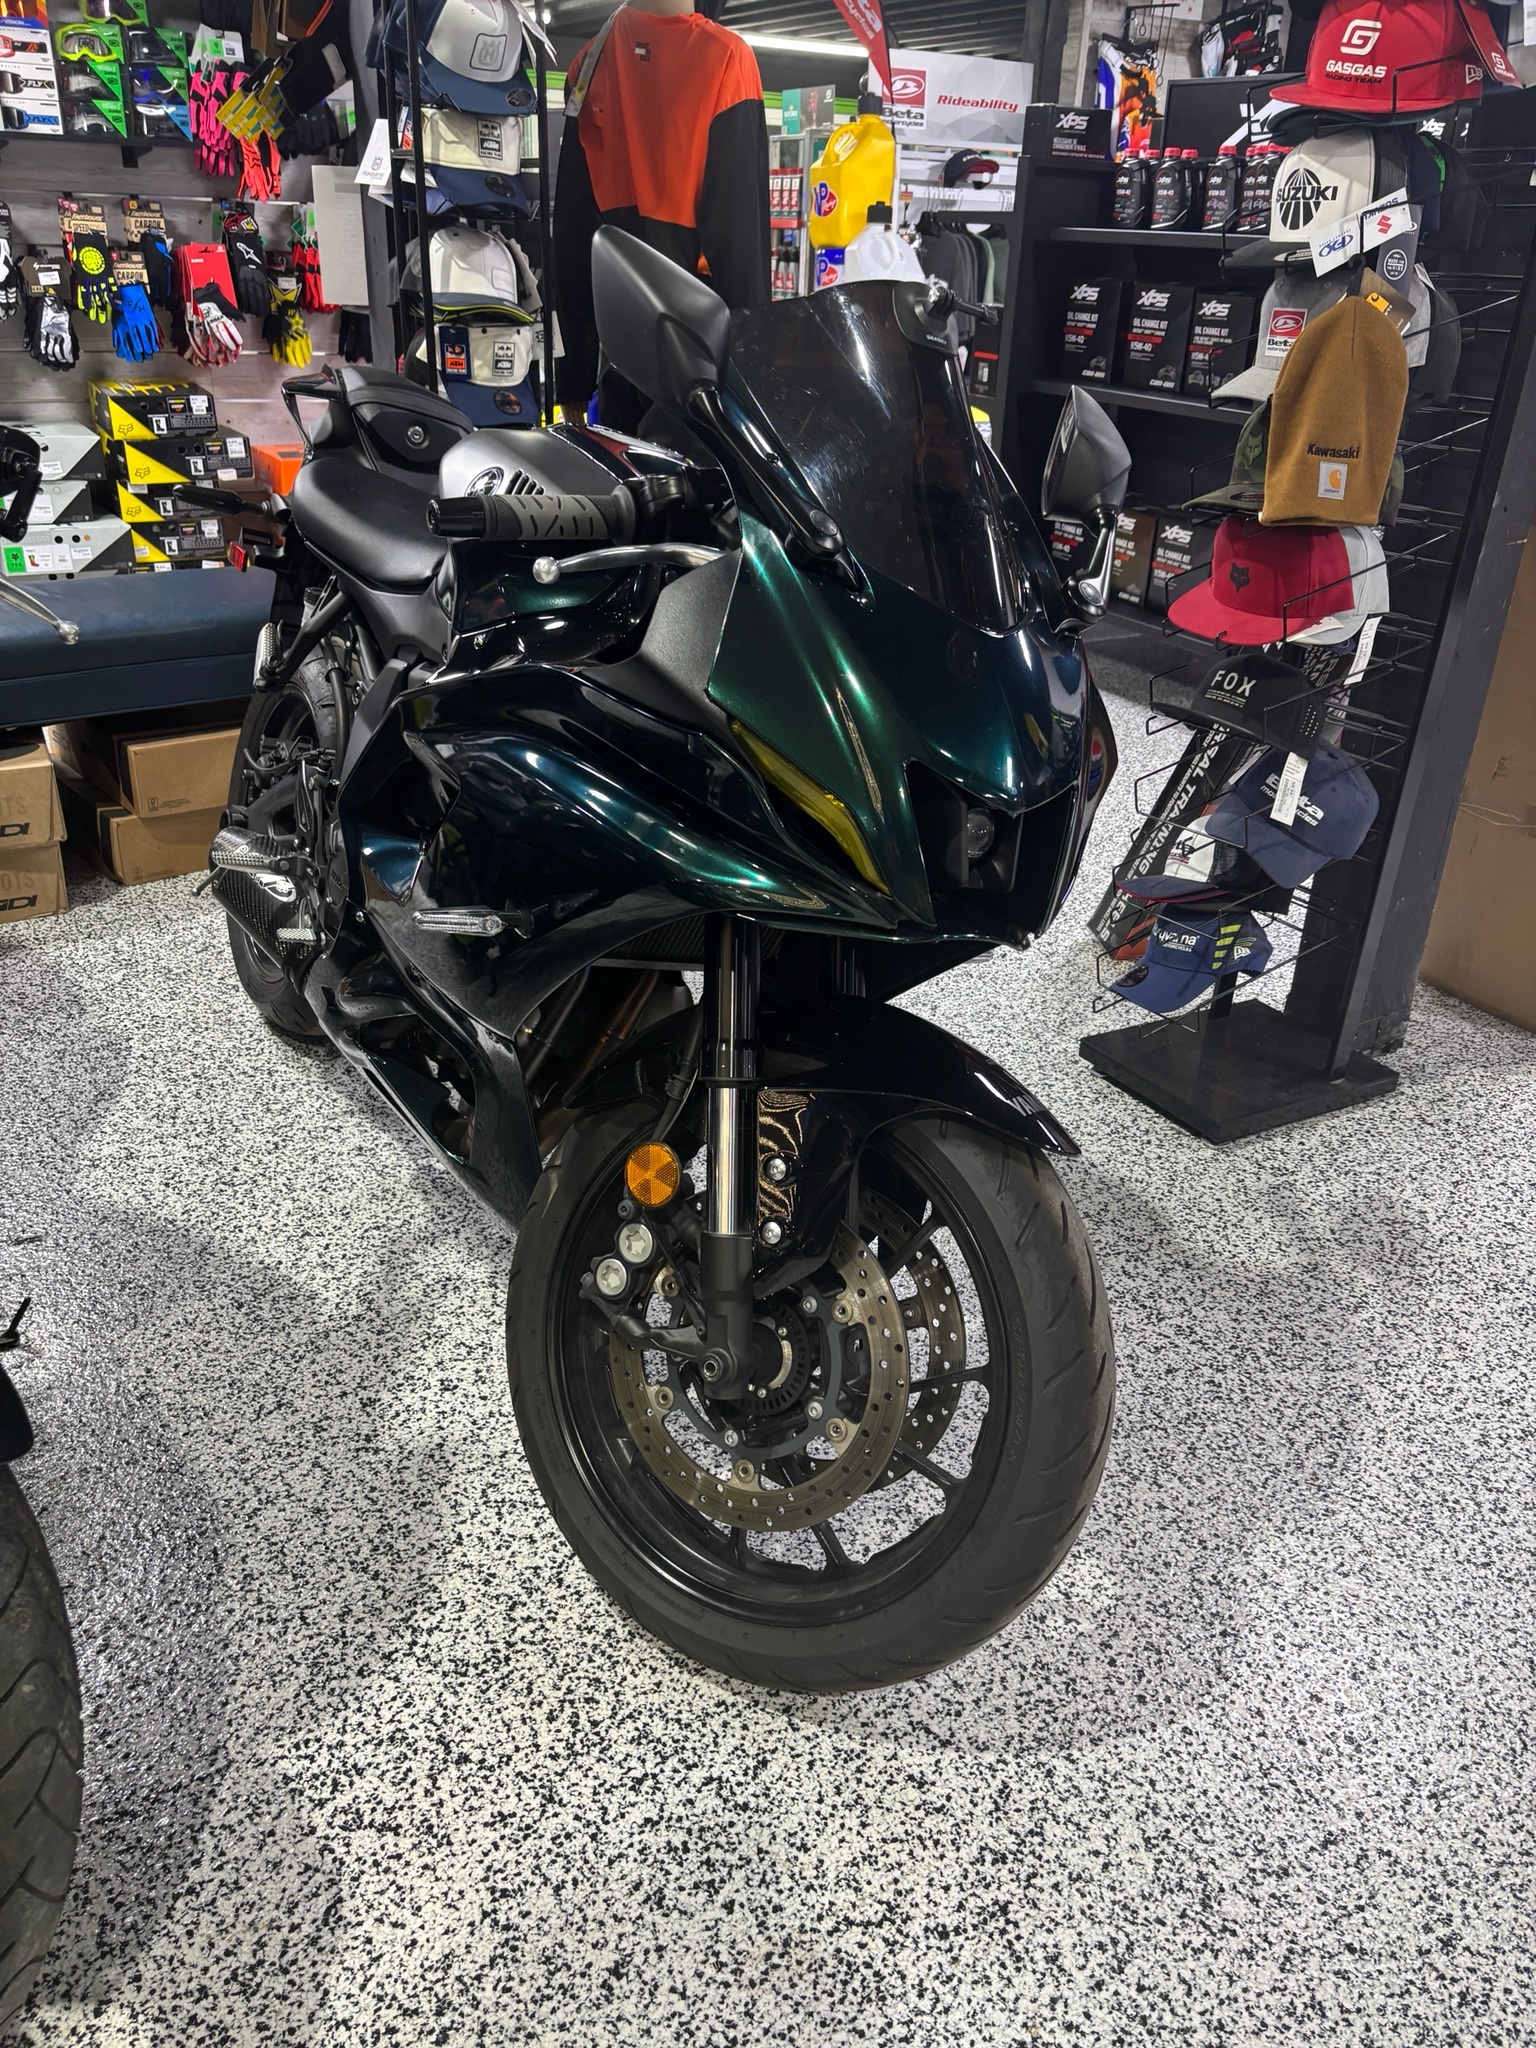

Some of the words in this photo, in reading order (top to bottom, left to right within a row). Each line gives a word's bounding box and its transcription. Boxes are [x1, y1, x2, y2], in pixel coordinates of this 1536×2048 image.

[1325, 73, 1352, 82] RACING
[1326, 60, 1387, 79] GASGAS
[937, 95, 1018, 112] Rideability
[1055, 112, 1090, 130] XPS
[1276, 186, 1338, 202] SUZUKI
[134, 220, 161, 229] CARBON
[1069, 283, 1100, 300] XPS
[1136, 290, 1171, 307] XPS
[1198, 300, 1232, 316] XPS
[1133, 318, 1141, 326] OIL
[1141, 319, 1160, 328] CHANGE
[1160, 320, 1168, 330] KIT
[1202, 327, 1220, 336] CHANGE
[1221, 328, 1229, 336] KIT
[1306, 442, 1360, 458] Kawasaki
[1161, 525, 1194, 544] XPS
[1165, 550, 1182, 560] CHANGE
[1182, 554, 1191, 563] KIT
[1211, 670, 1257, 697] FOX
